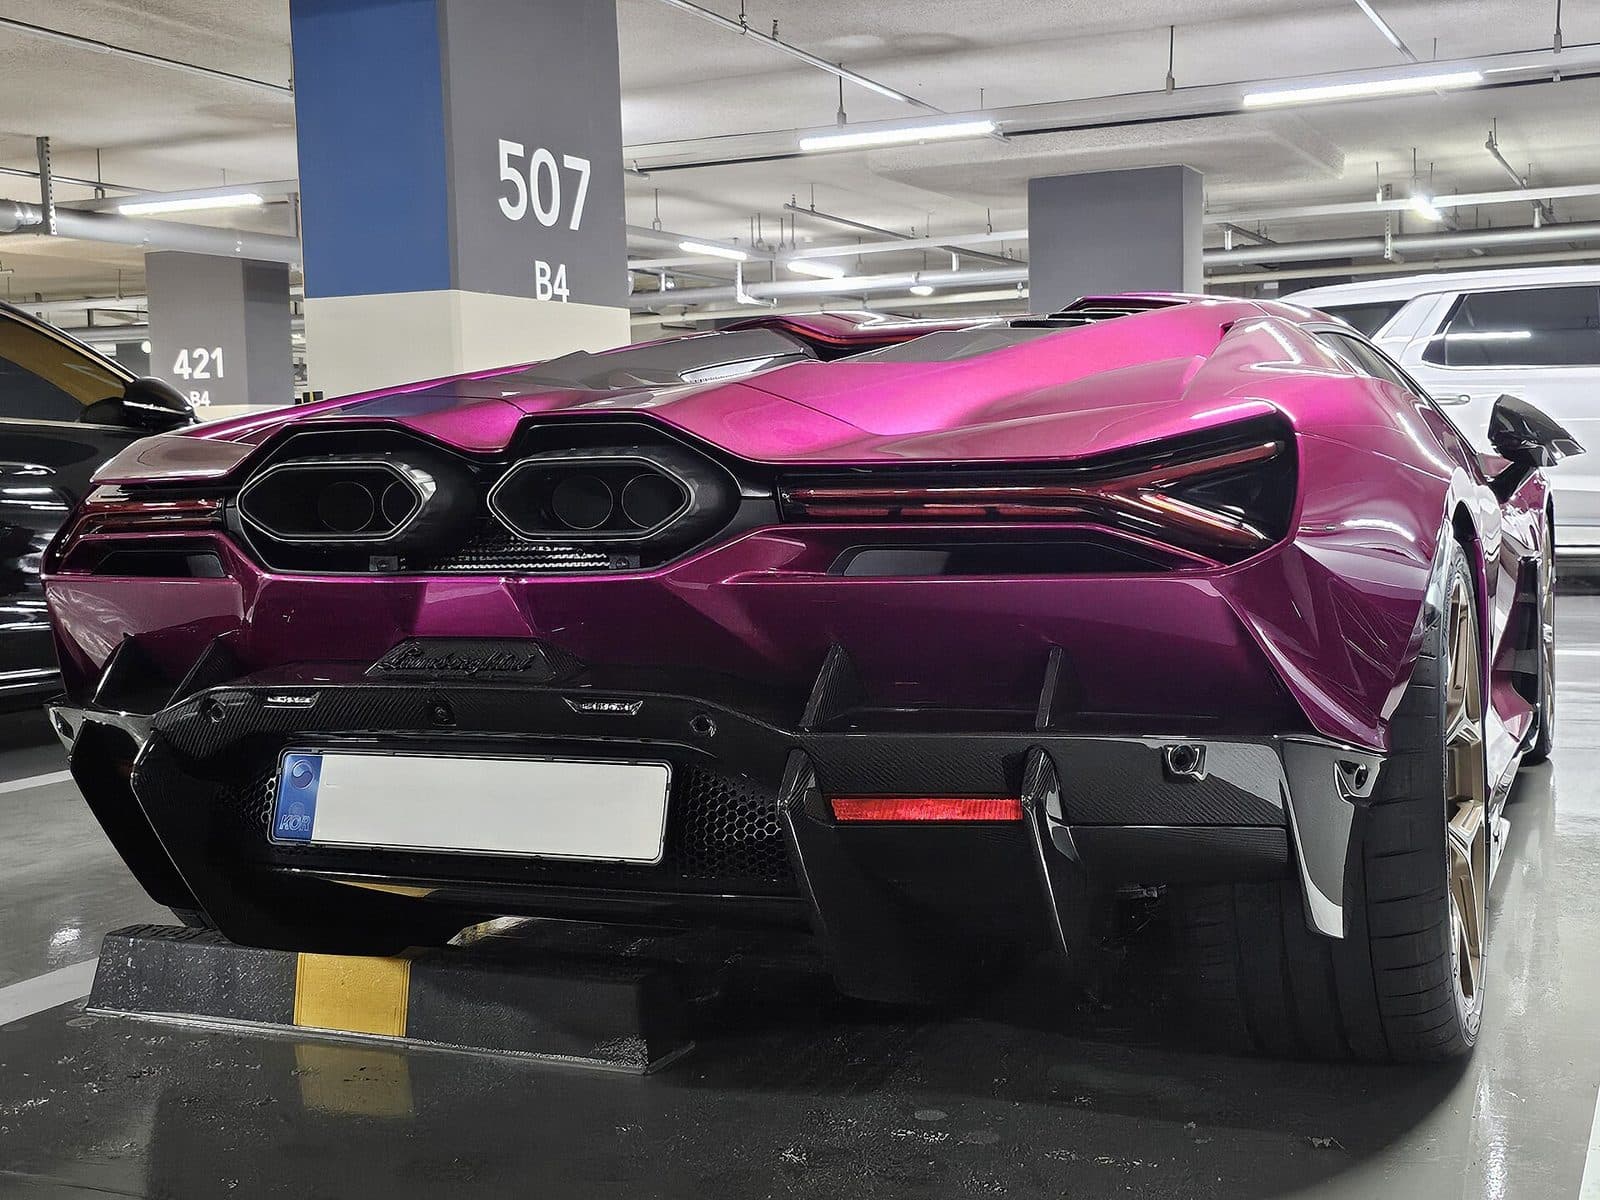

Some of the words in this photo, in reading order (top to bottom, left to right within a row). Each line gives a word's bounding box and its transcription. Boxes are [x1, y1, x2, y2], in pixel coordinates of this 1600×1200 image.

[498, 139, 591, 231] 507
[535, 260, 570, 304] B4
[173, 347, 224, 380] 421
[190, 391, 211, 407] B4
[279, 814, 311, 832] KOR
